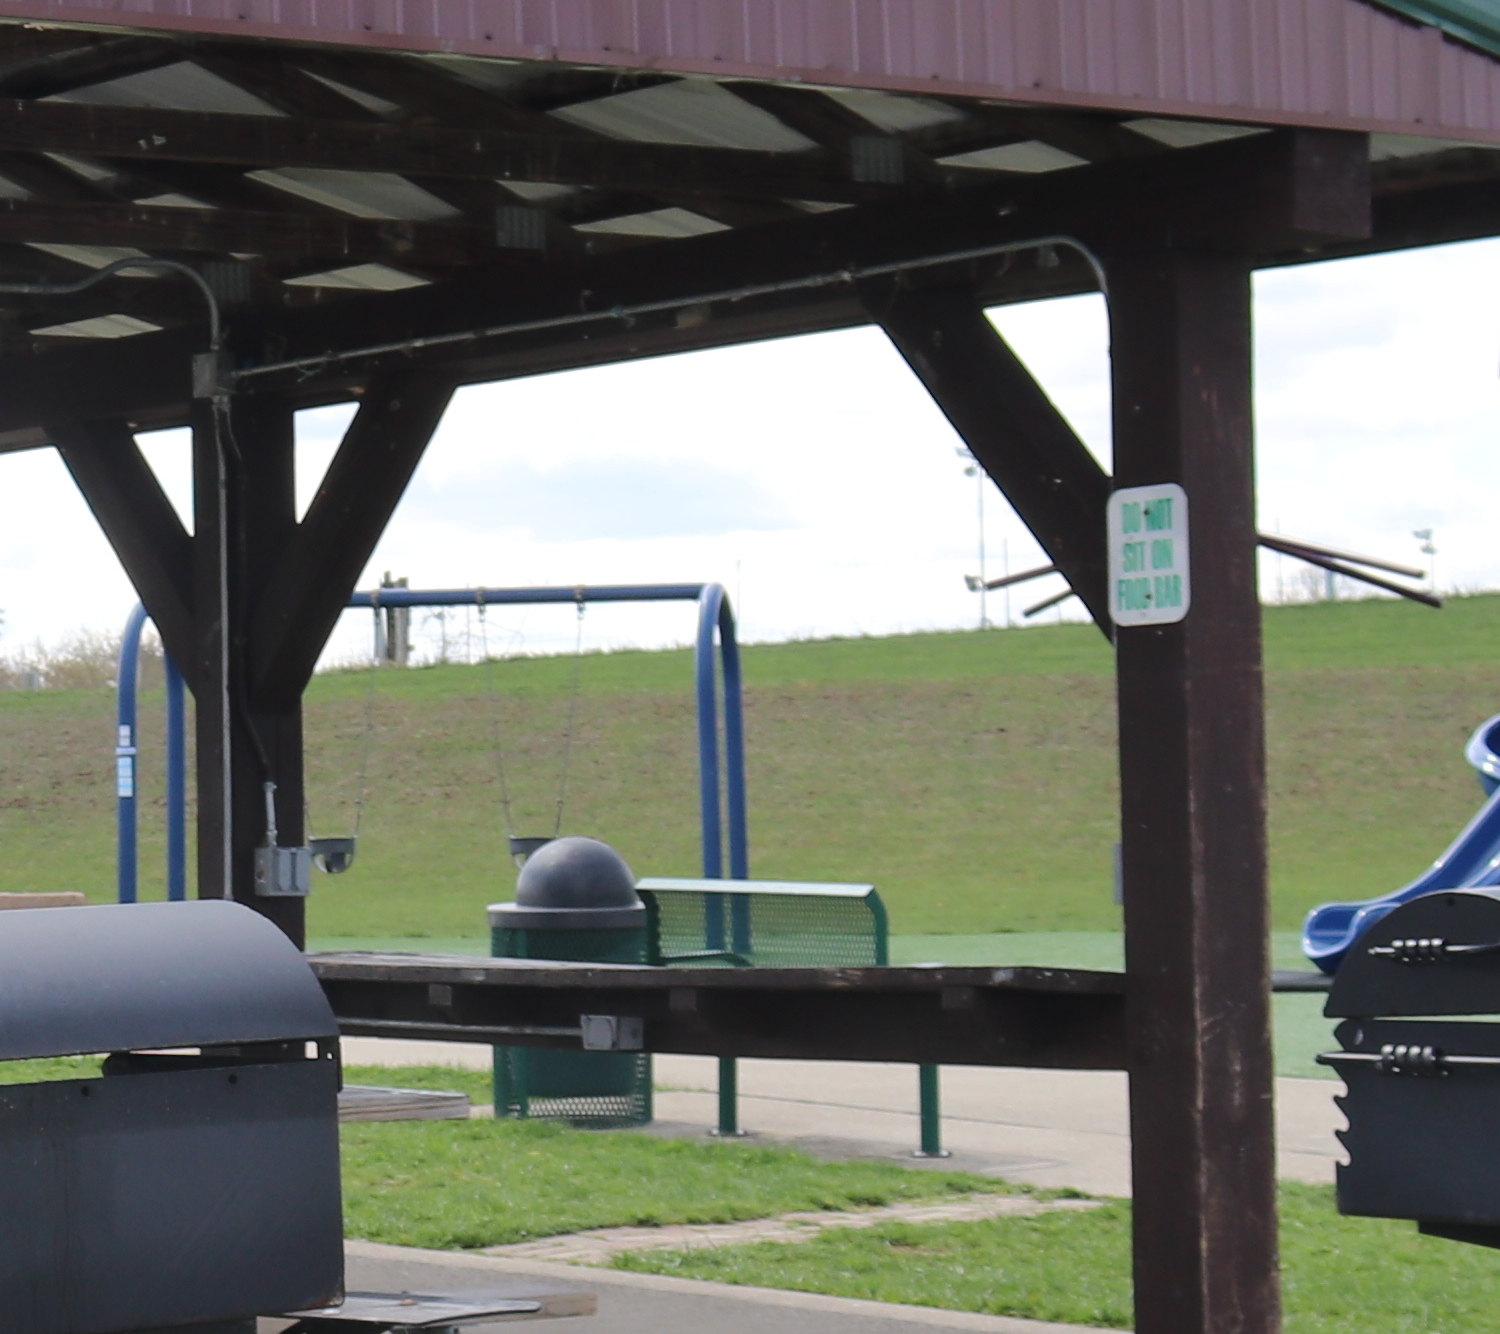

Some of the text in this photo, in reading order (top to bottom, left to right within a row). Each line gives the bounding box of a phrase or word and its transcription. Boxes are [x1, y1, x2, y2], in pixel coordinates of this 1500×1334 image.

[1122, 497, 1173, 534] DO NOT
[1122, 538, 1174, 572] SIT ON
[1118, 574, 1182, 611] FOOD BAR
